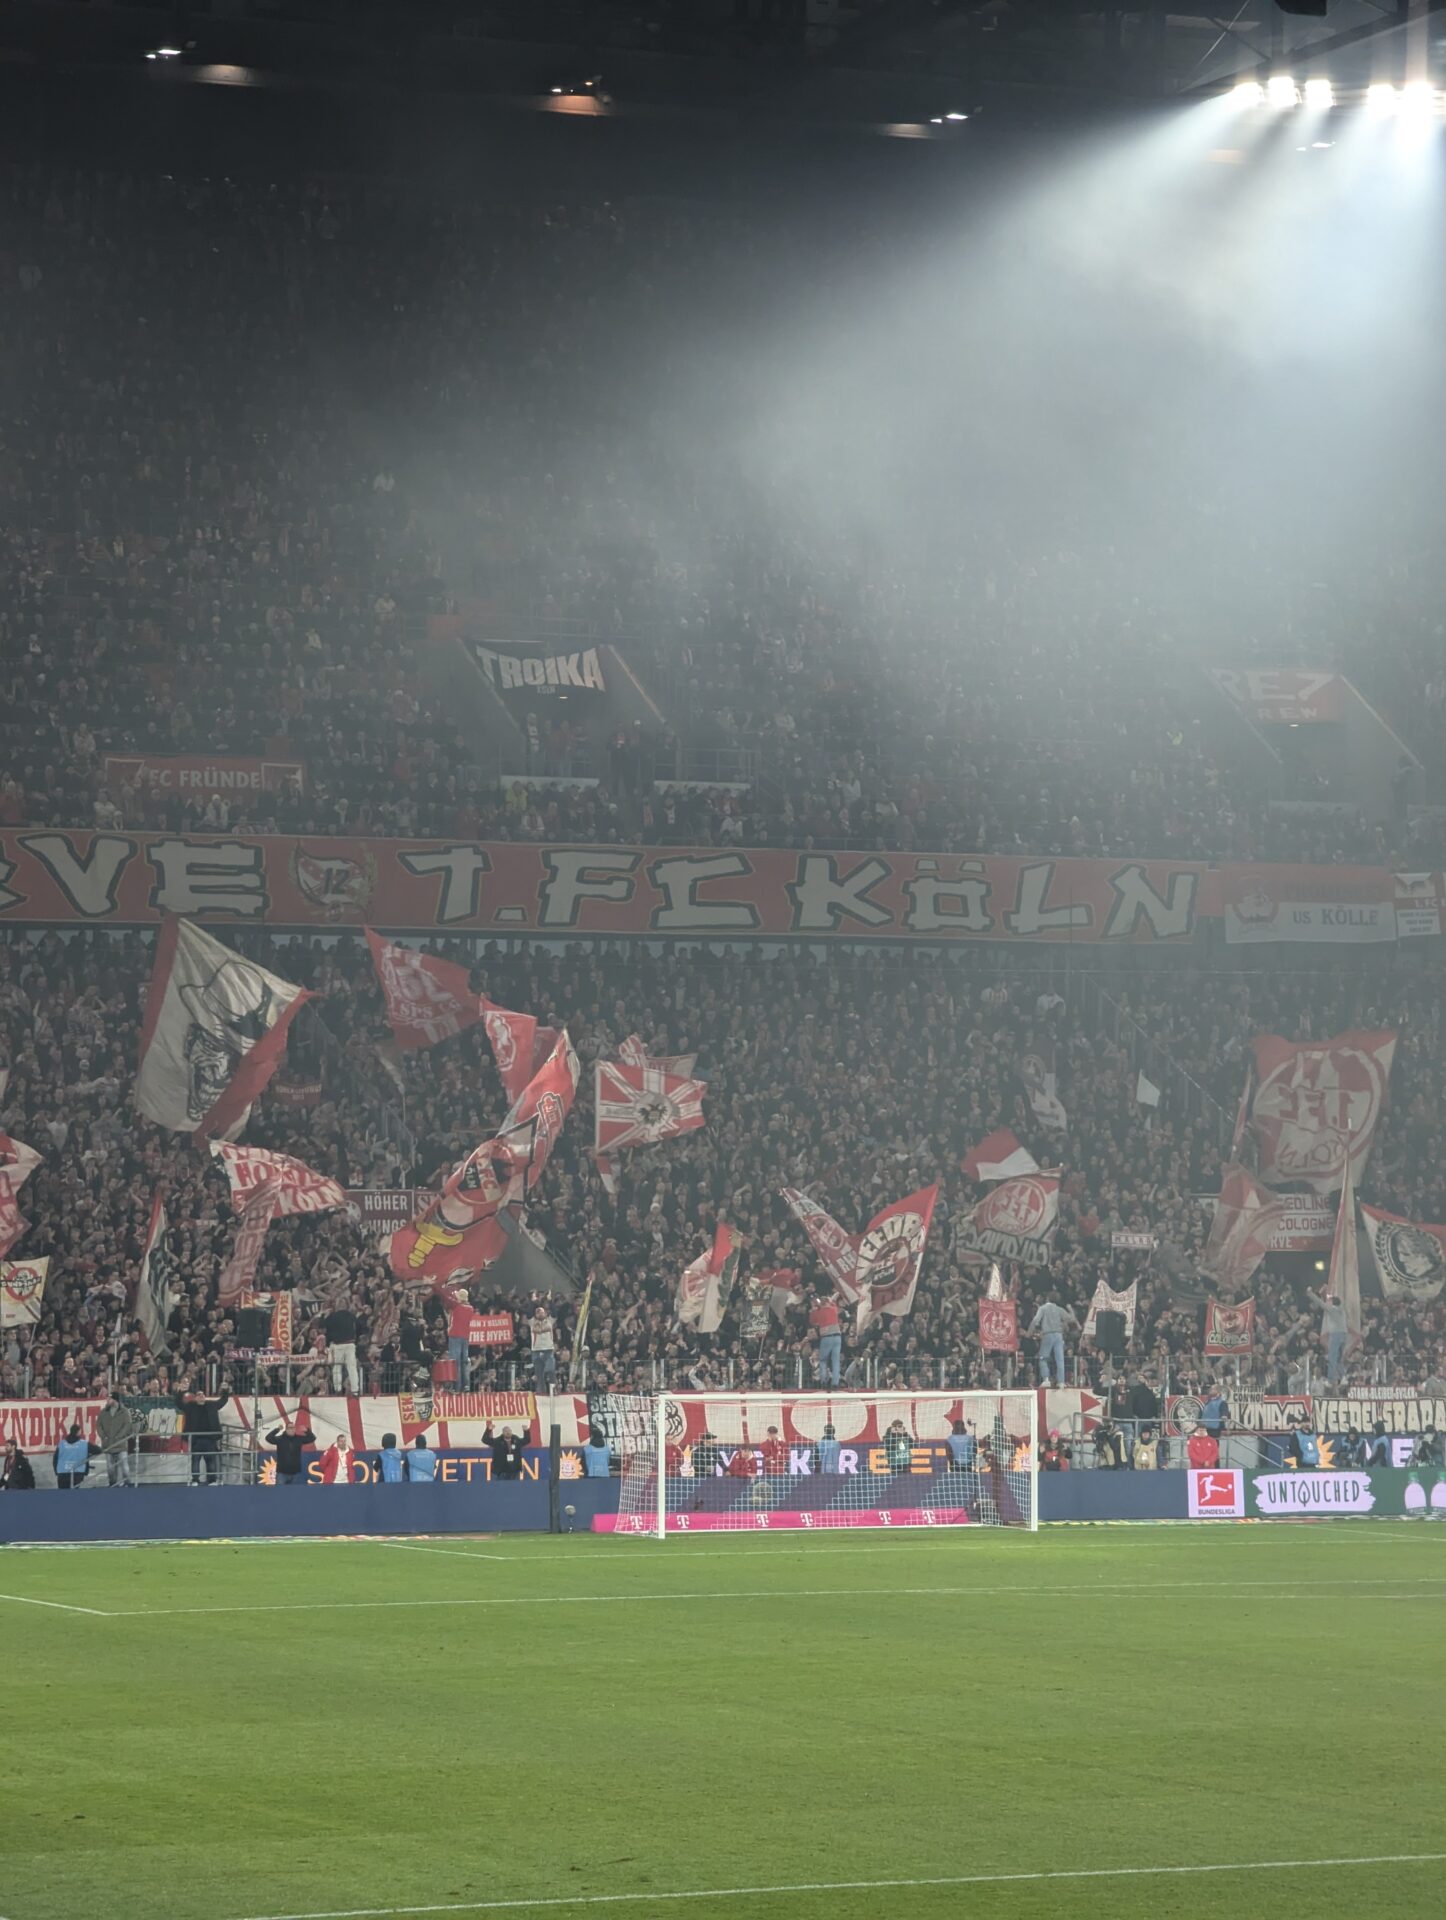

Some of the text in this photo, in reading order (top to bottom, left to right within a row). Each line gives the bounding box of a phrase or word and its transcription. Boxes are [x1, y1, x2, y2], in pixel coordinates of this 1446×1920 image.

[476, 645, 606, 693] TROIKA
[179, 766, 261, 788] FRÜNDE
[785, 852, 1198, 938] KÖLN
[1292, 910, 1312, 924] US
[1321, 904, 1379, 926] KÖLLE
[364, 1191, 408, 1211] HÖHER
[1279, 1217, 1334, 1231] COLOGNE
[468, 1329, 511, 1342] THE HYPE!
[432, 1390, 532, 1420] STADIONVERBOT
[1267, 1480, 1360, 1506] UNTOUCHED
